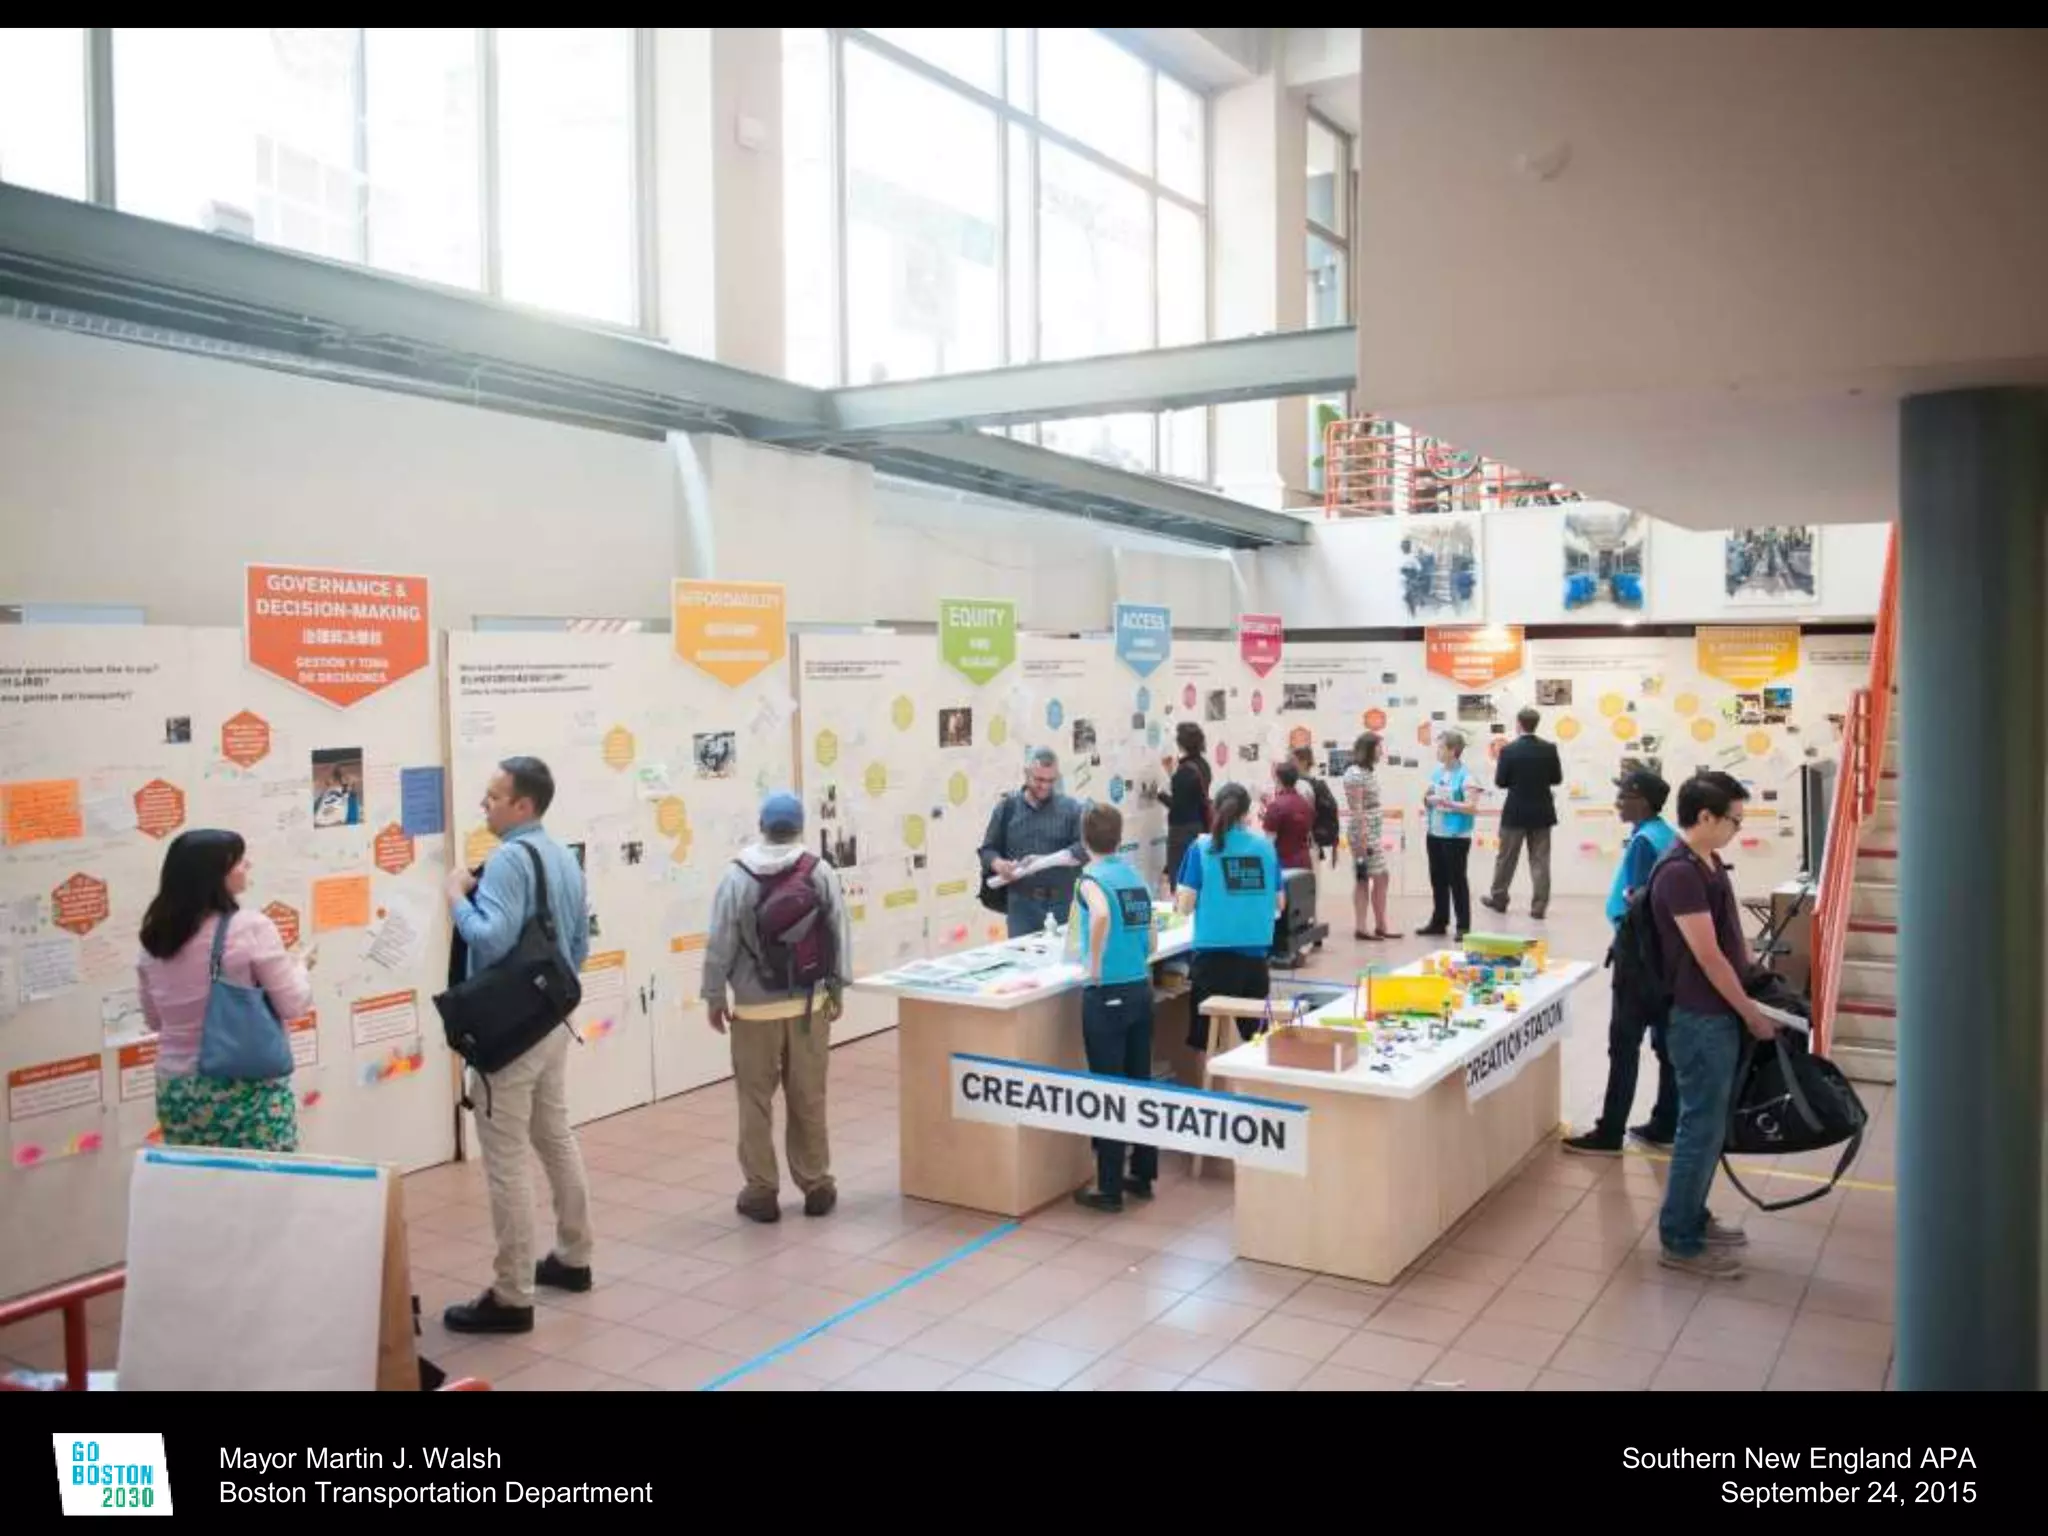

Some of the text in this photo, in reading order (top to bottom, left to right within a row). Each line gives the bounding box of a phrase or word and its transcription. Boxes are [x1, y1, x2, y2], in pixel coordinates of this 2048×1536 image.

[266, 573, 407, 598] GOVERNANCE &
[255, 598, 422, 622] DECISION-MAKING
[949, 605, 1006, 628] EQUITY
[1122, 611, 1166, 631] ACCESS
[962, 1072, 1287, 1151] CREATION STATION
